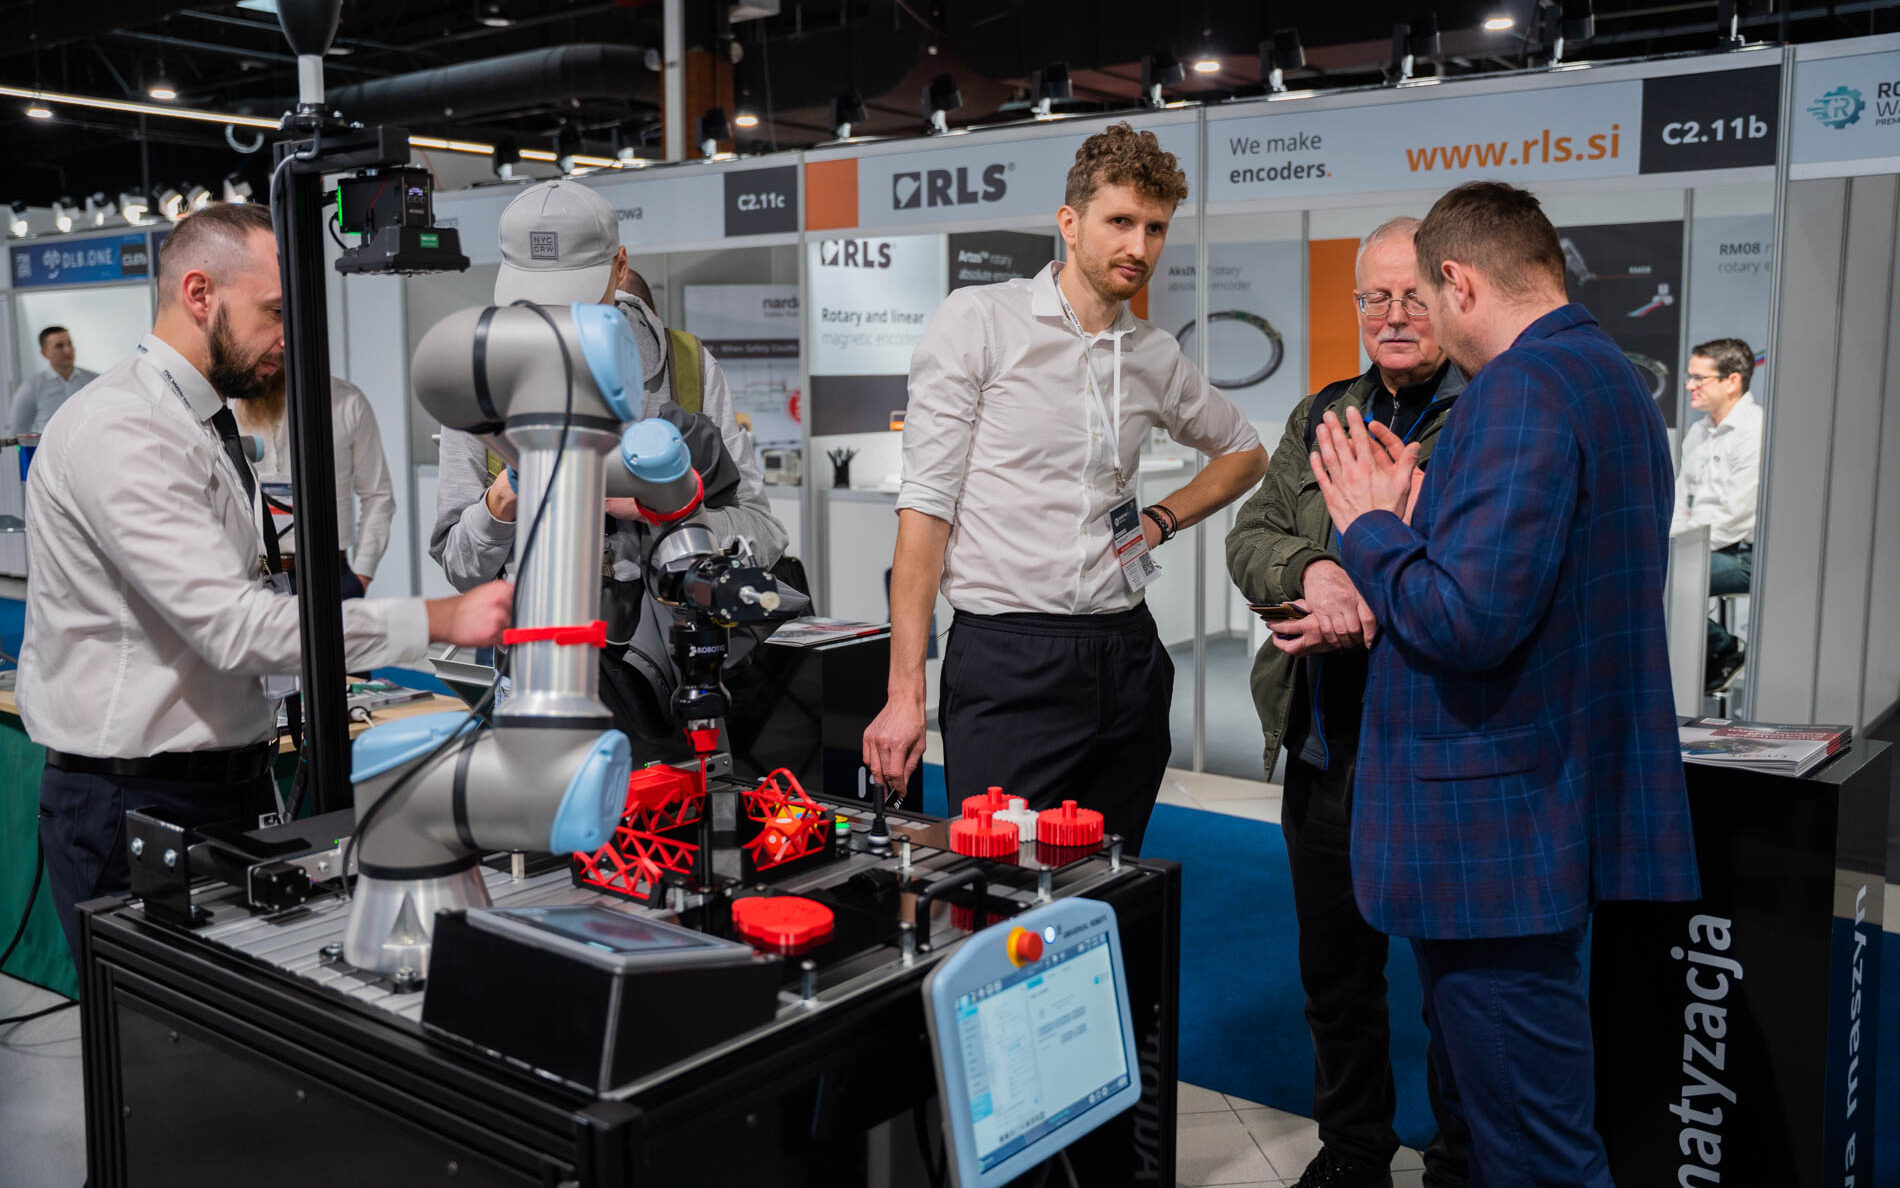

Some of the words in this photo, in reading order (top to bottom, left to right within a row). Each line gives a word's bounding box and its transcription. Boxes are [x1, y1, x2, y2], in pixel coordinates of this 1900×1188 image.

[1662, 115, 1767, 145] C2.11b
[1230, 137, 1260, 156] We
[1267, 132, 1322, 153] make
[1406, 124, 1620, 171] www.rls.si
[1230, 161, 1332, 183] encoders.
[737, 192, 785, 211] C2.11c
[1719, 242, 1761, 255] RM08
[1719, 260, 1760, 274] rotary
[1211, 281, 1250, 292] encoder
[822, 308, 862, 327] Rotary
[865, 309, 888, 323] and
[891, 310, 924, 324] linear
[1847, 885, 1867, 1120] maszyn
